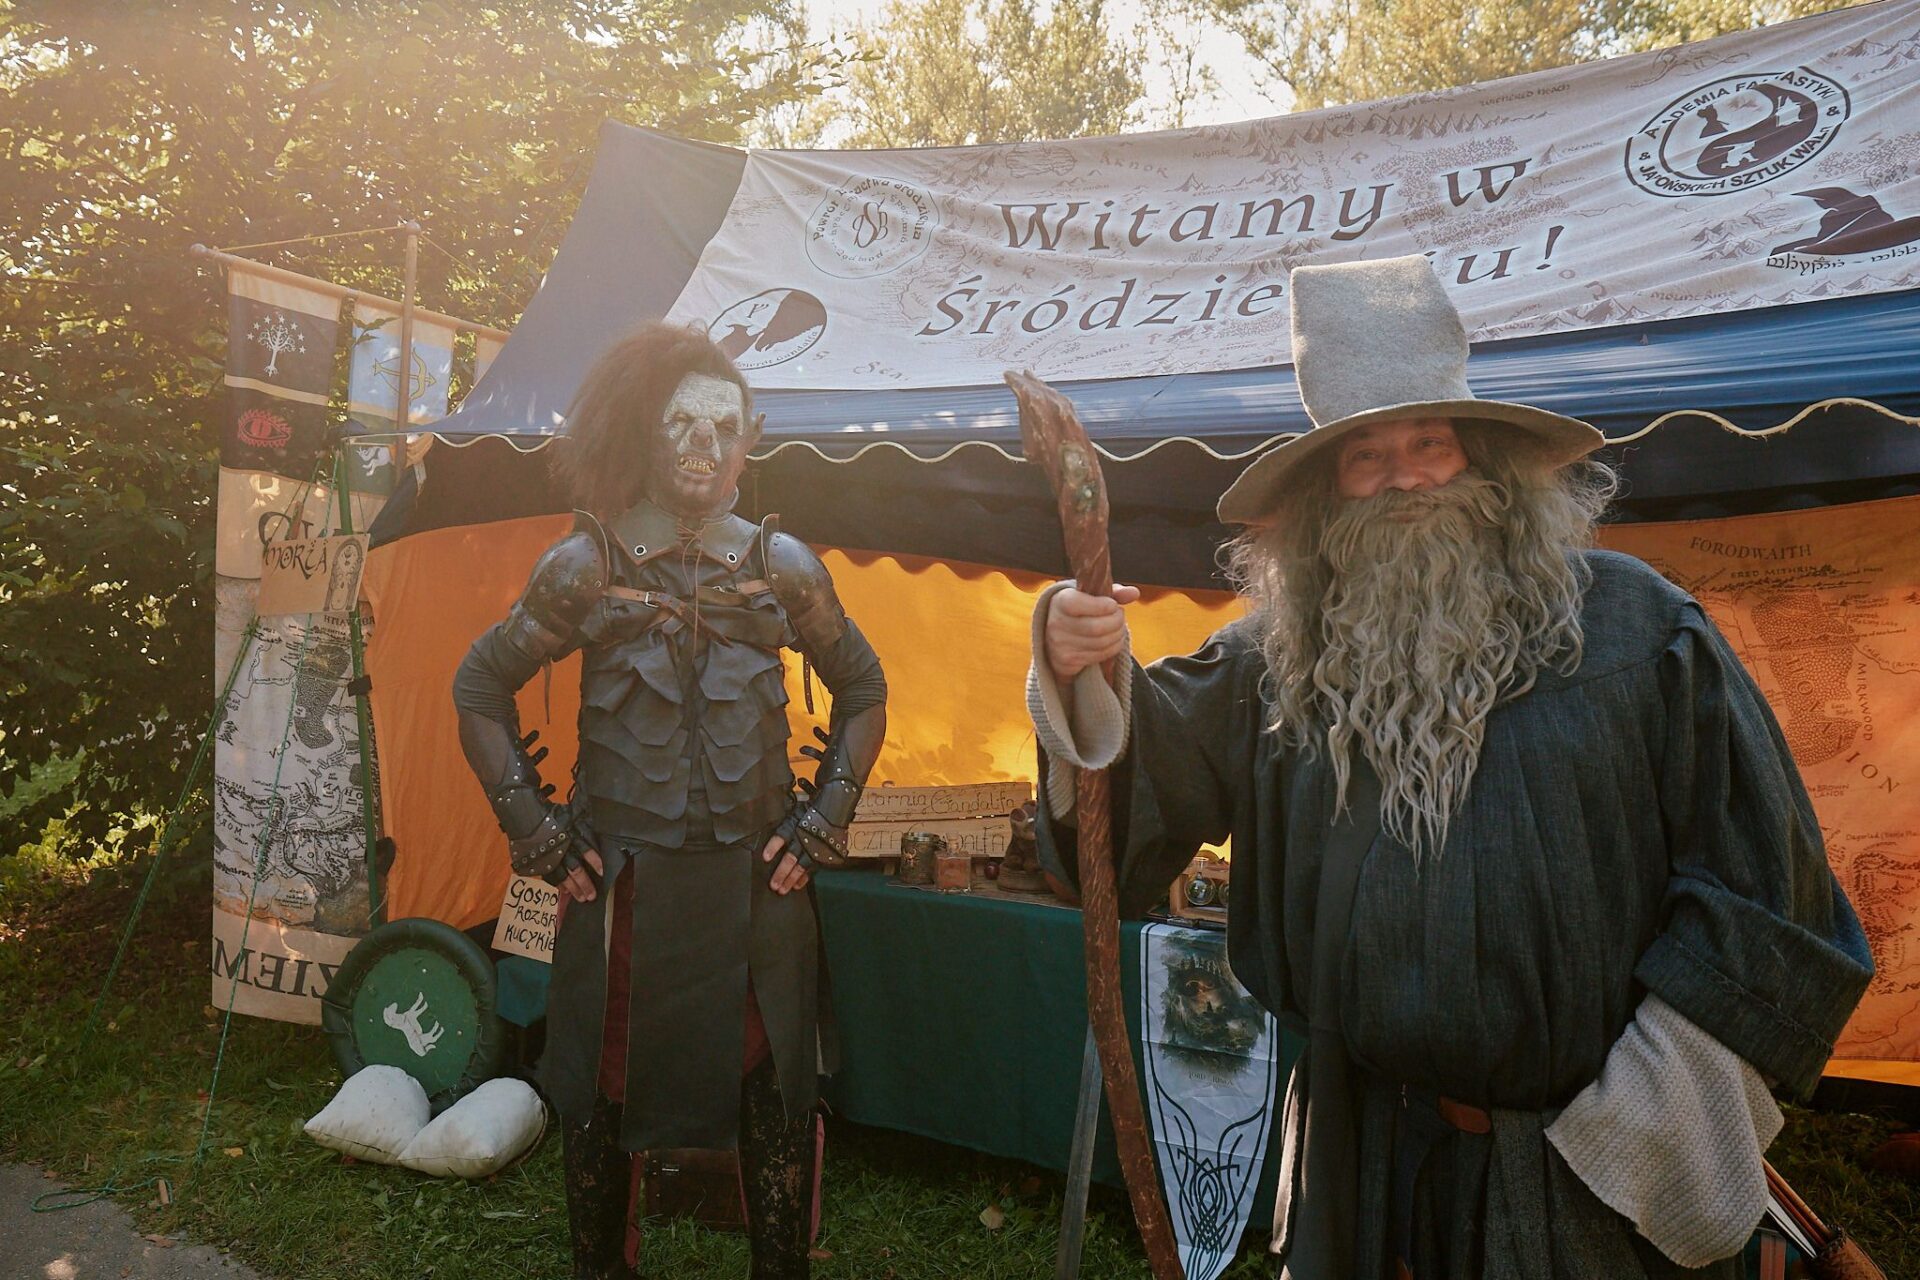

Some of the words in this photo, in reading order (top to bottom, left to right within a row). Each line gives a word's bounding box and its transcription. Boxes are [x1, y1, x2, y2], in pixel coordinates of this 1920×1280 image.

[1644, 87, 1730, 139] ADEMIA
[1735, 70, 1837, 99] FAASTYKI
[993, 181, 1393, 252] Witamy
[1440, 156, 1533, 209] w
[1730, 161, 1796, 188] SZTUK
[1690, 536, 1813, 561] FORODWAITH
[1856, 662, 1874, 742] MIRKWOOD
